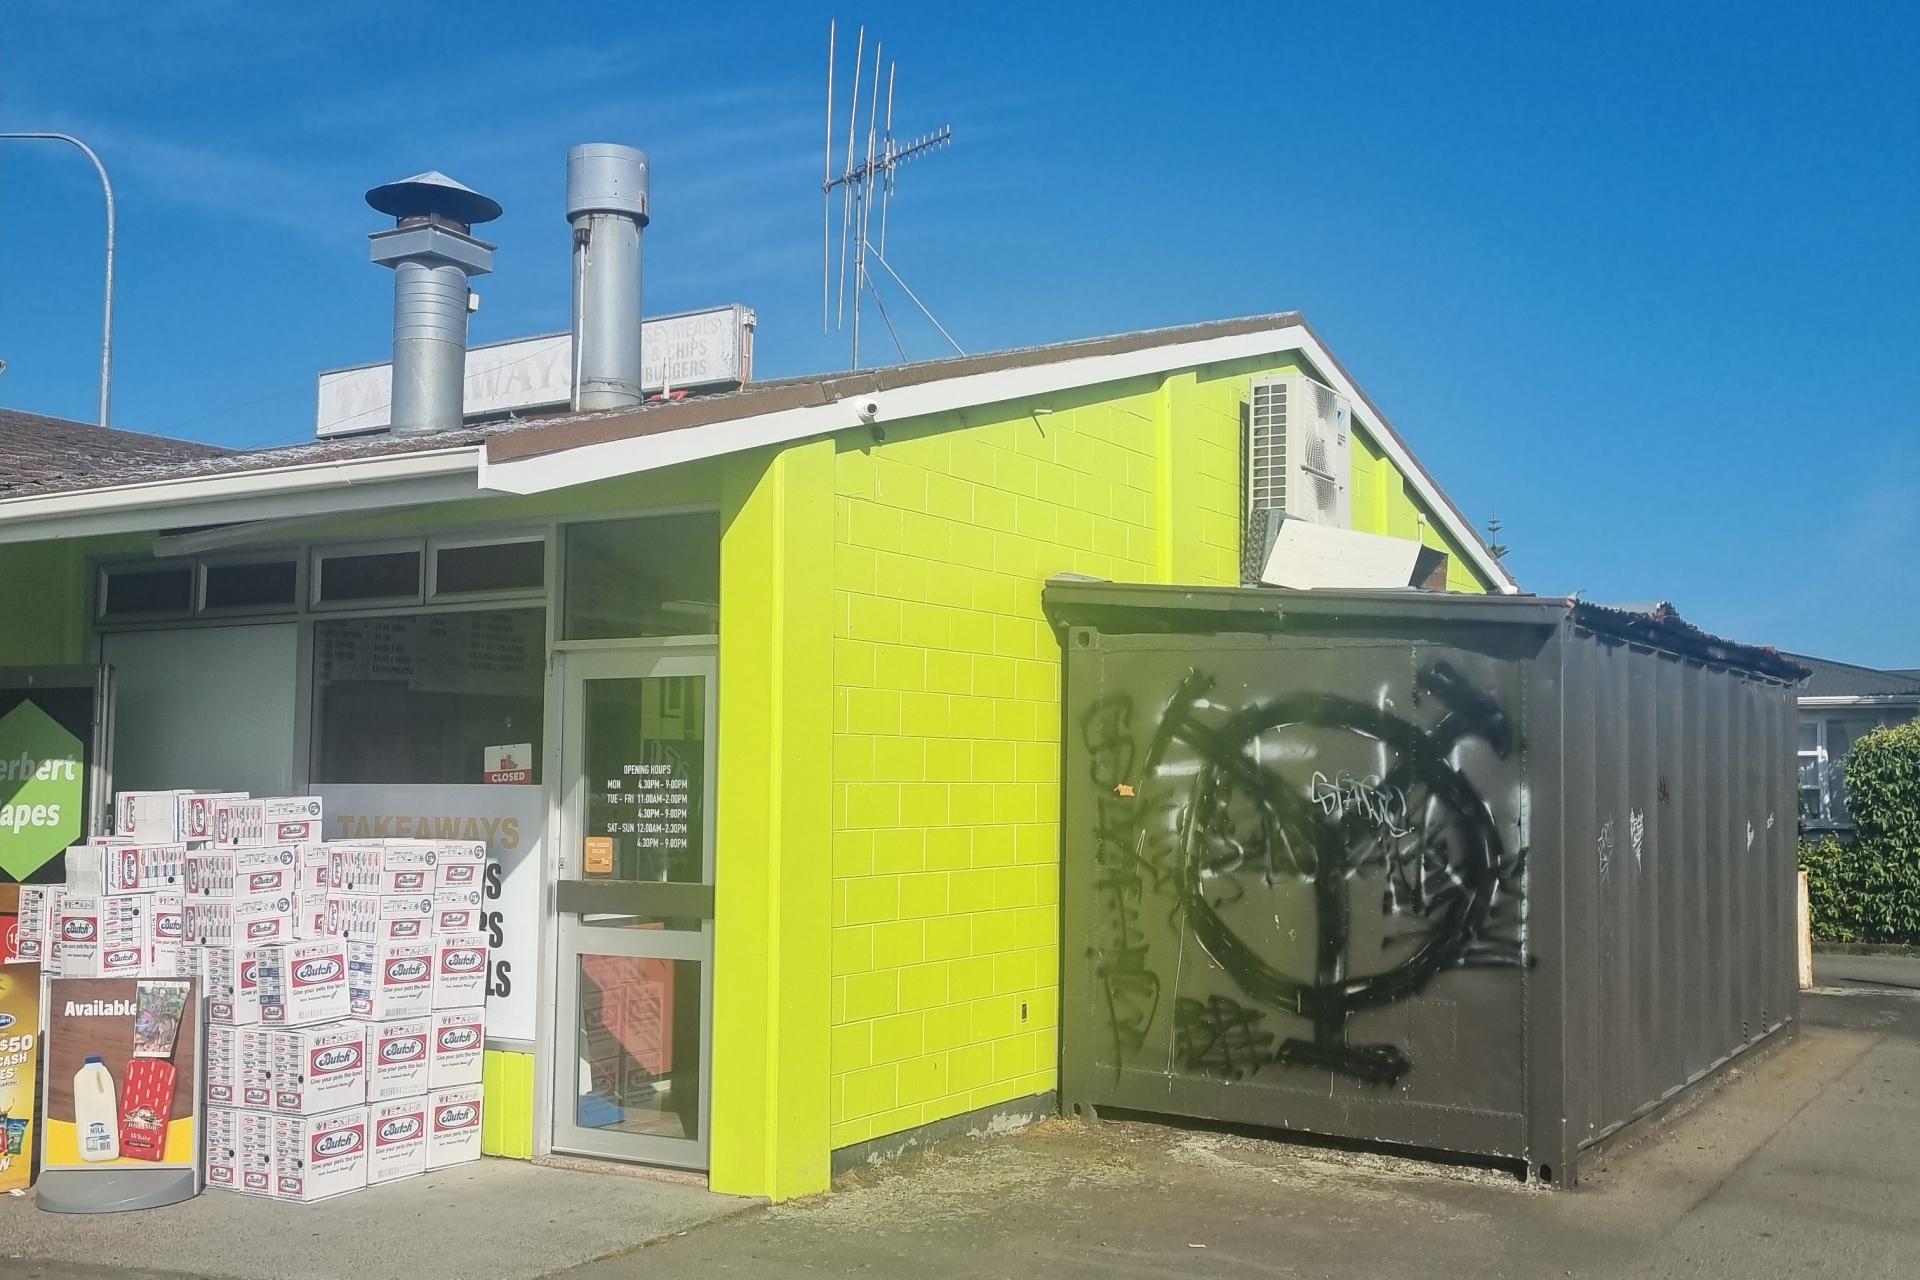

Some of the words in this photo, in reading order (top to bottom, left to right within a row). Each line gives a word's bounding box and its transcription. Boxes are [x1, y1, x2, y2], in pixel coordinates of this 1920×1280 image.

[644, 360, 706, 382] BUGERS
[492, 771, 525, 782] CLOSED
[624, 765, 649, 774] OPENING
[607, 779, 620, 789] MON
[624, 794, 634, 804] FRI
[337, 816, 520, 850] TAKEAWAYS
[66, 922, 90, 934] Butch
[109, 953, 134, 963] Butch
[448, 953, 477, 966] Butch
[300, 961, 333, 978] Butch
[392, 963, 422, 976] Butch
[64, 1000, 137, 1016] Available
[444, 1030, 472, 1044] Butch
[386, 1041, 416, 1056] Butch
[319, 1049, 351, 1066] Butch
[442, 1108, 470, 1123] Butch
[90, 1126, 105, 1134] MILK
[384, 1120, 414, 1136] Butch
[320, 1133, 353, 1151] Butch
